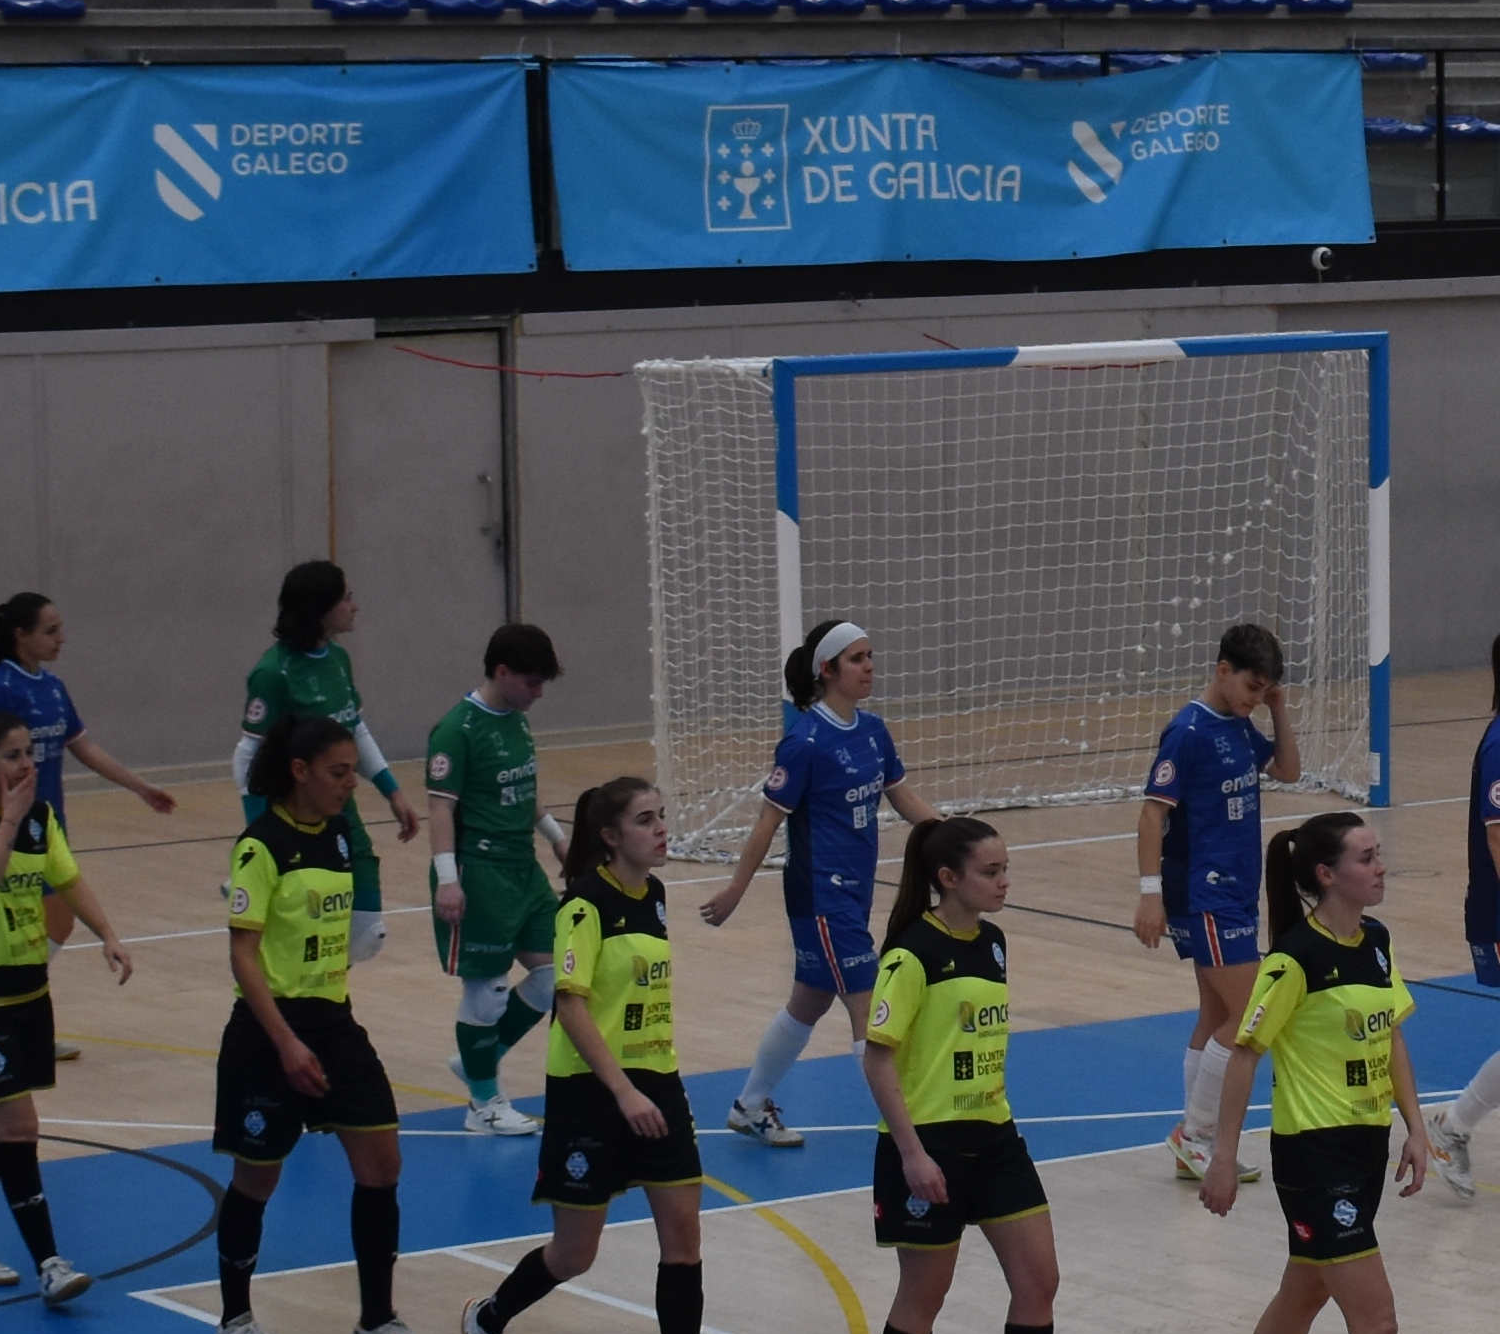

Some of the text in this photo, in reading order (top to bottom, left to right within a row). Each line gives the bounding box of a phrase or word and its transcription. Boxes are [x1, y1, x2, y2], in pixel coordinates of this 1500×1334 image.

[802, 112, 938, 154] XUNTA
[1130, 103, 1231, 135] DEPORTE
[231, 122, 363, 148] DEPORTE
[1130, 131, 1221, 162] GALEGO
[231, 151, 348, 177] GALEGO
[803, 162, 1021, 205] DE GALICIA
[1214, 737, 1232, 754] 55
